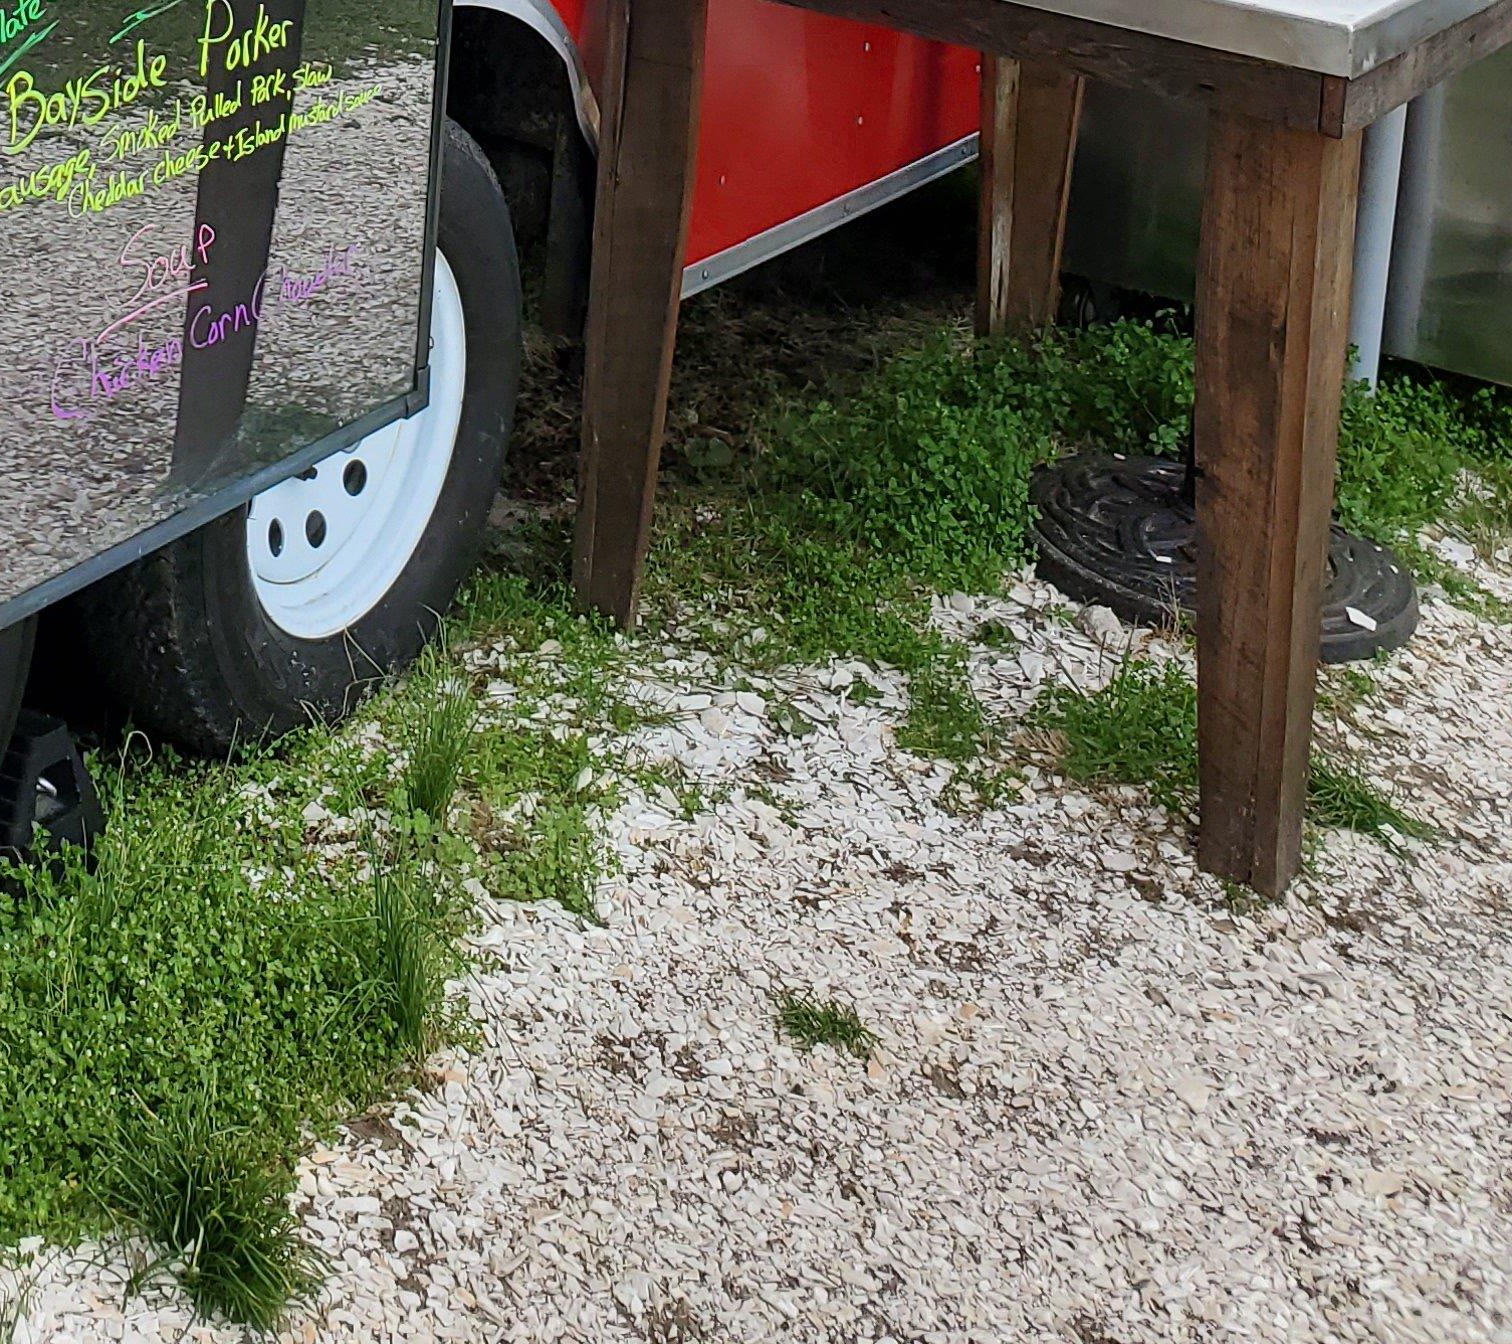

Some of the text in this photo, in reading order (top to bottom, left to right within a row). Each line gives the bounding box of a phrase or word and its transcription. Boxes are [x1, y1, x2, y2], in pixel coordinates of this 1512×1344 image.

[99, 99, 181, 164] Smoked
[189, 80, 242, 130] Pulled
[68, 170, 149, 220] Cheddar
[233, 113, 286, 162] Island
[190, 304, 251, 349] Corn
